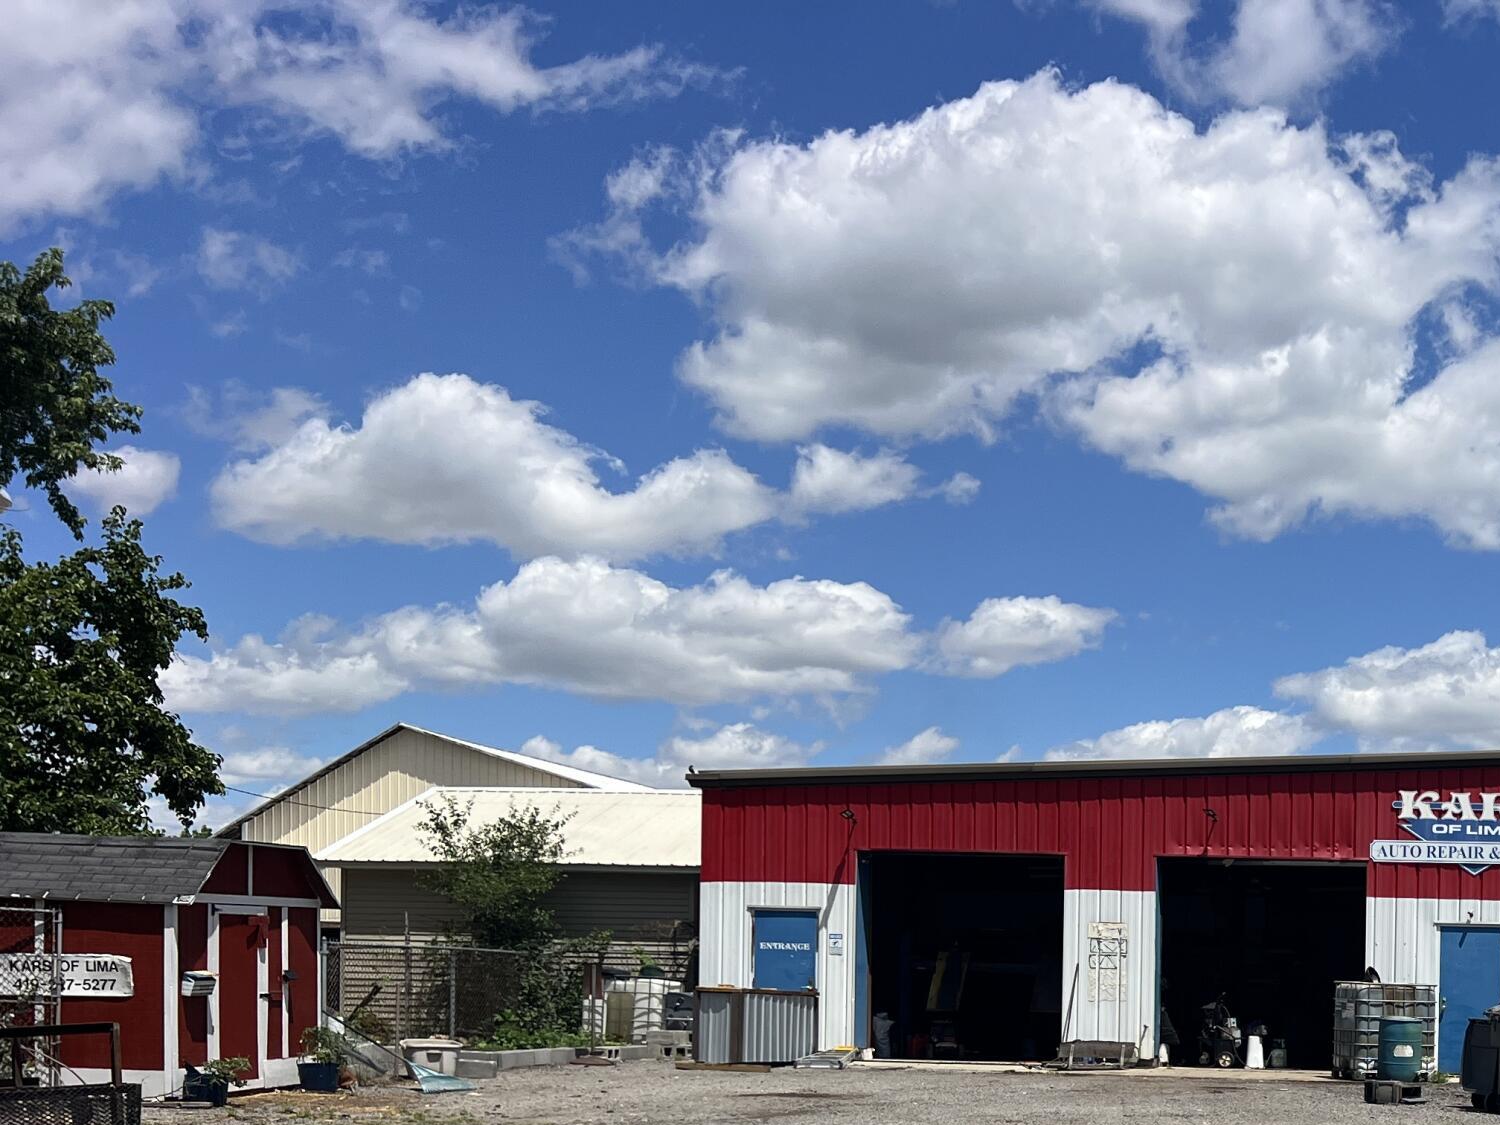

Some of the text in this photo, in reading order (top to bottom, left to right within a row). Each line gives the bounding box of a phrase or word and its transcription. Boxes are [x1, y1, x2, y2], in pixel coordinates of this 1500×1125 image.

[1431, 824, 1461, 835] OF
[1376, 845, 1422, 858] AUTO
[1426, 846, 1484, 860] REPAIR
[1489, 847, 1500, 860] &
[759, 942, 810, 951] ENTRANCE
[9, 960, 119, 973] KARS OF LIMA
